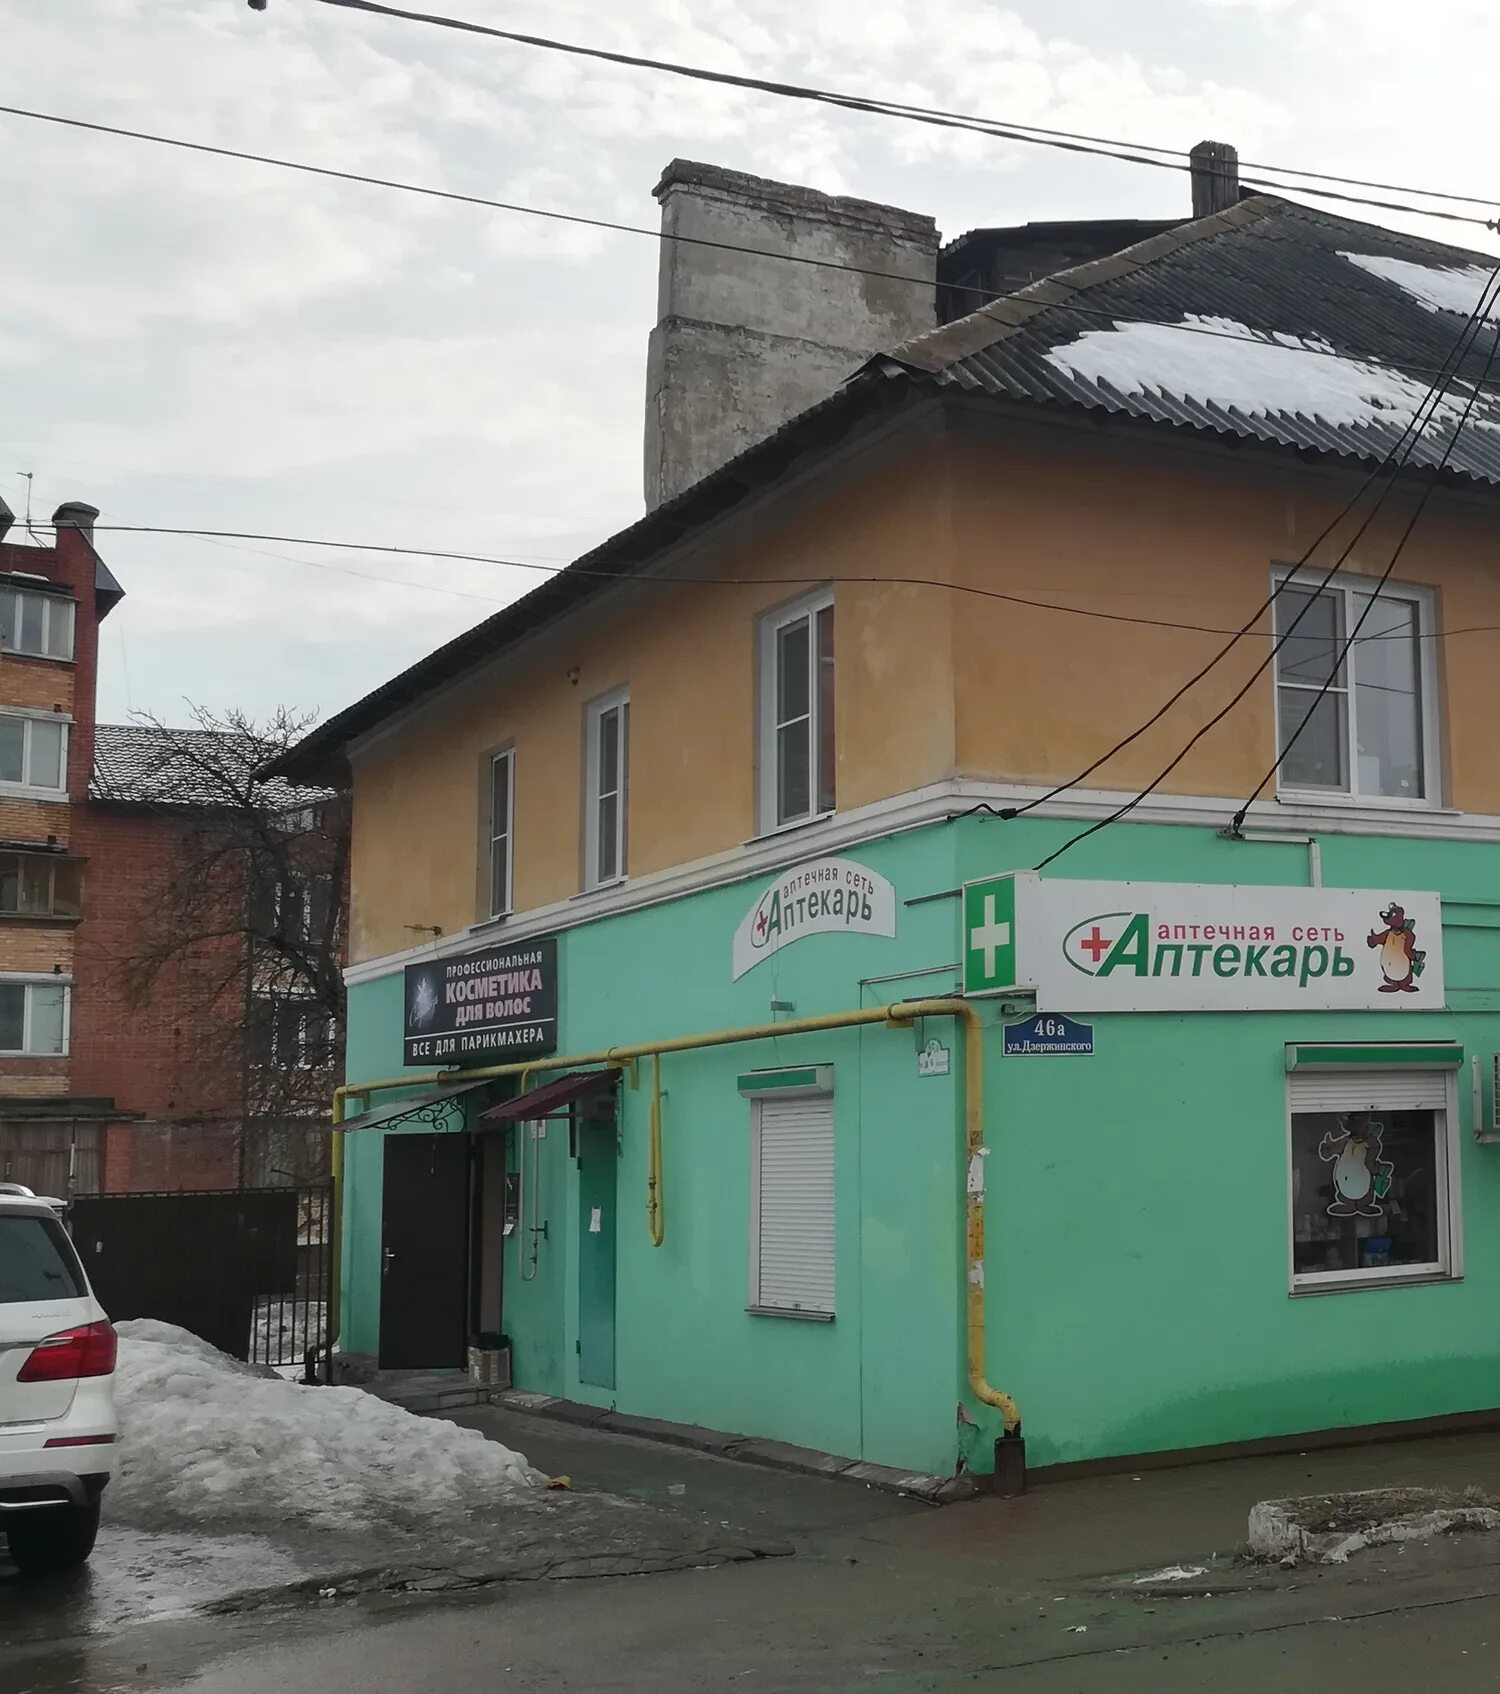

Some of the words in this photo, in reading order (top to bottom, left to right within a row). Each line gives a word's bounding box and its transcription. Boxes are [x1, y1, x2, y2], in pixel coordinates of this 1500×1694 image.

[783, 867, 839, 898] аптечная
[846, 870, 874, 895] сеть
[1157, 923, 1275, 941] аптечная
[1292, 926, 1345, 942] сеть
[446, 950, 543, 978] ПРОФЕССИОНАЛЬНАЯ
[1094, 913, 1355, 988] Аптекарь
[446, 969, 543, 1004] КОСМЕТИКА
[455, 1004, 483, 1027] ДЛЯ
[486, 997, 531, 1019] ВОЛОС
[412, 1042, 430, 1057] ВСЕ
[435, 1038, 455, 1056] ДЛЯ
[461, 1027, 544, 1051] ПАРИКМАХЕРА
[1034, 1019, 1065, 1036] 46а
